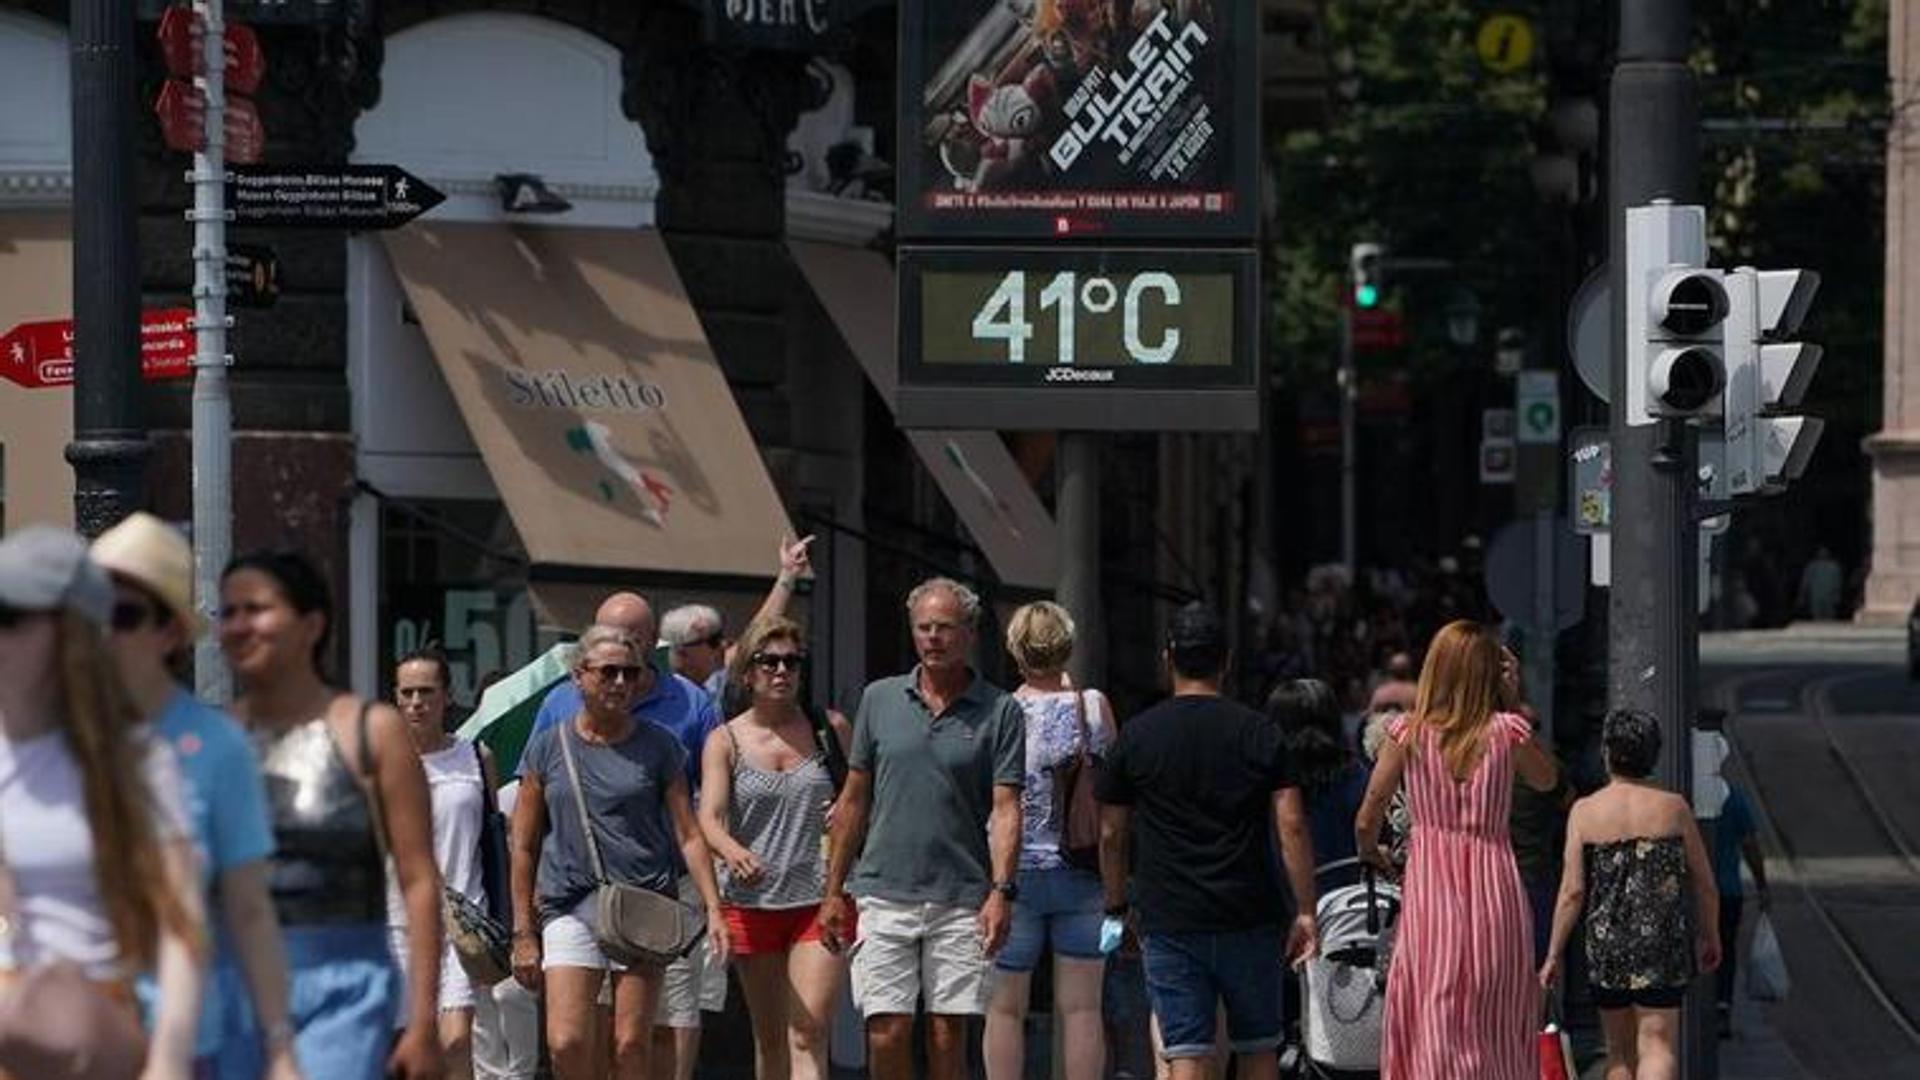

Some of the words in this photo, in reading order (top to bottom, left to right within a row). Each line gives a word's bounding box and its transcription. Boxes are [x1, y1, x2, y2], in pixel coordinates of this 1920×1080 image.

[1049, 9, 1173, 171] BULLET
[1101, 20, 1209, 146] TRAIN
[973, 270, 1181, 364] 41°C
[507, 370, 666, 409] Stiletto
[1045, 367, 1114, 381] JCDecaux
